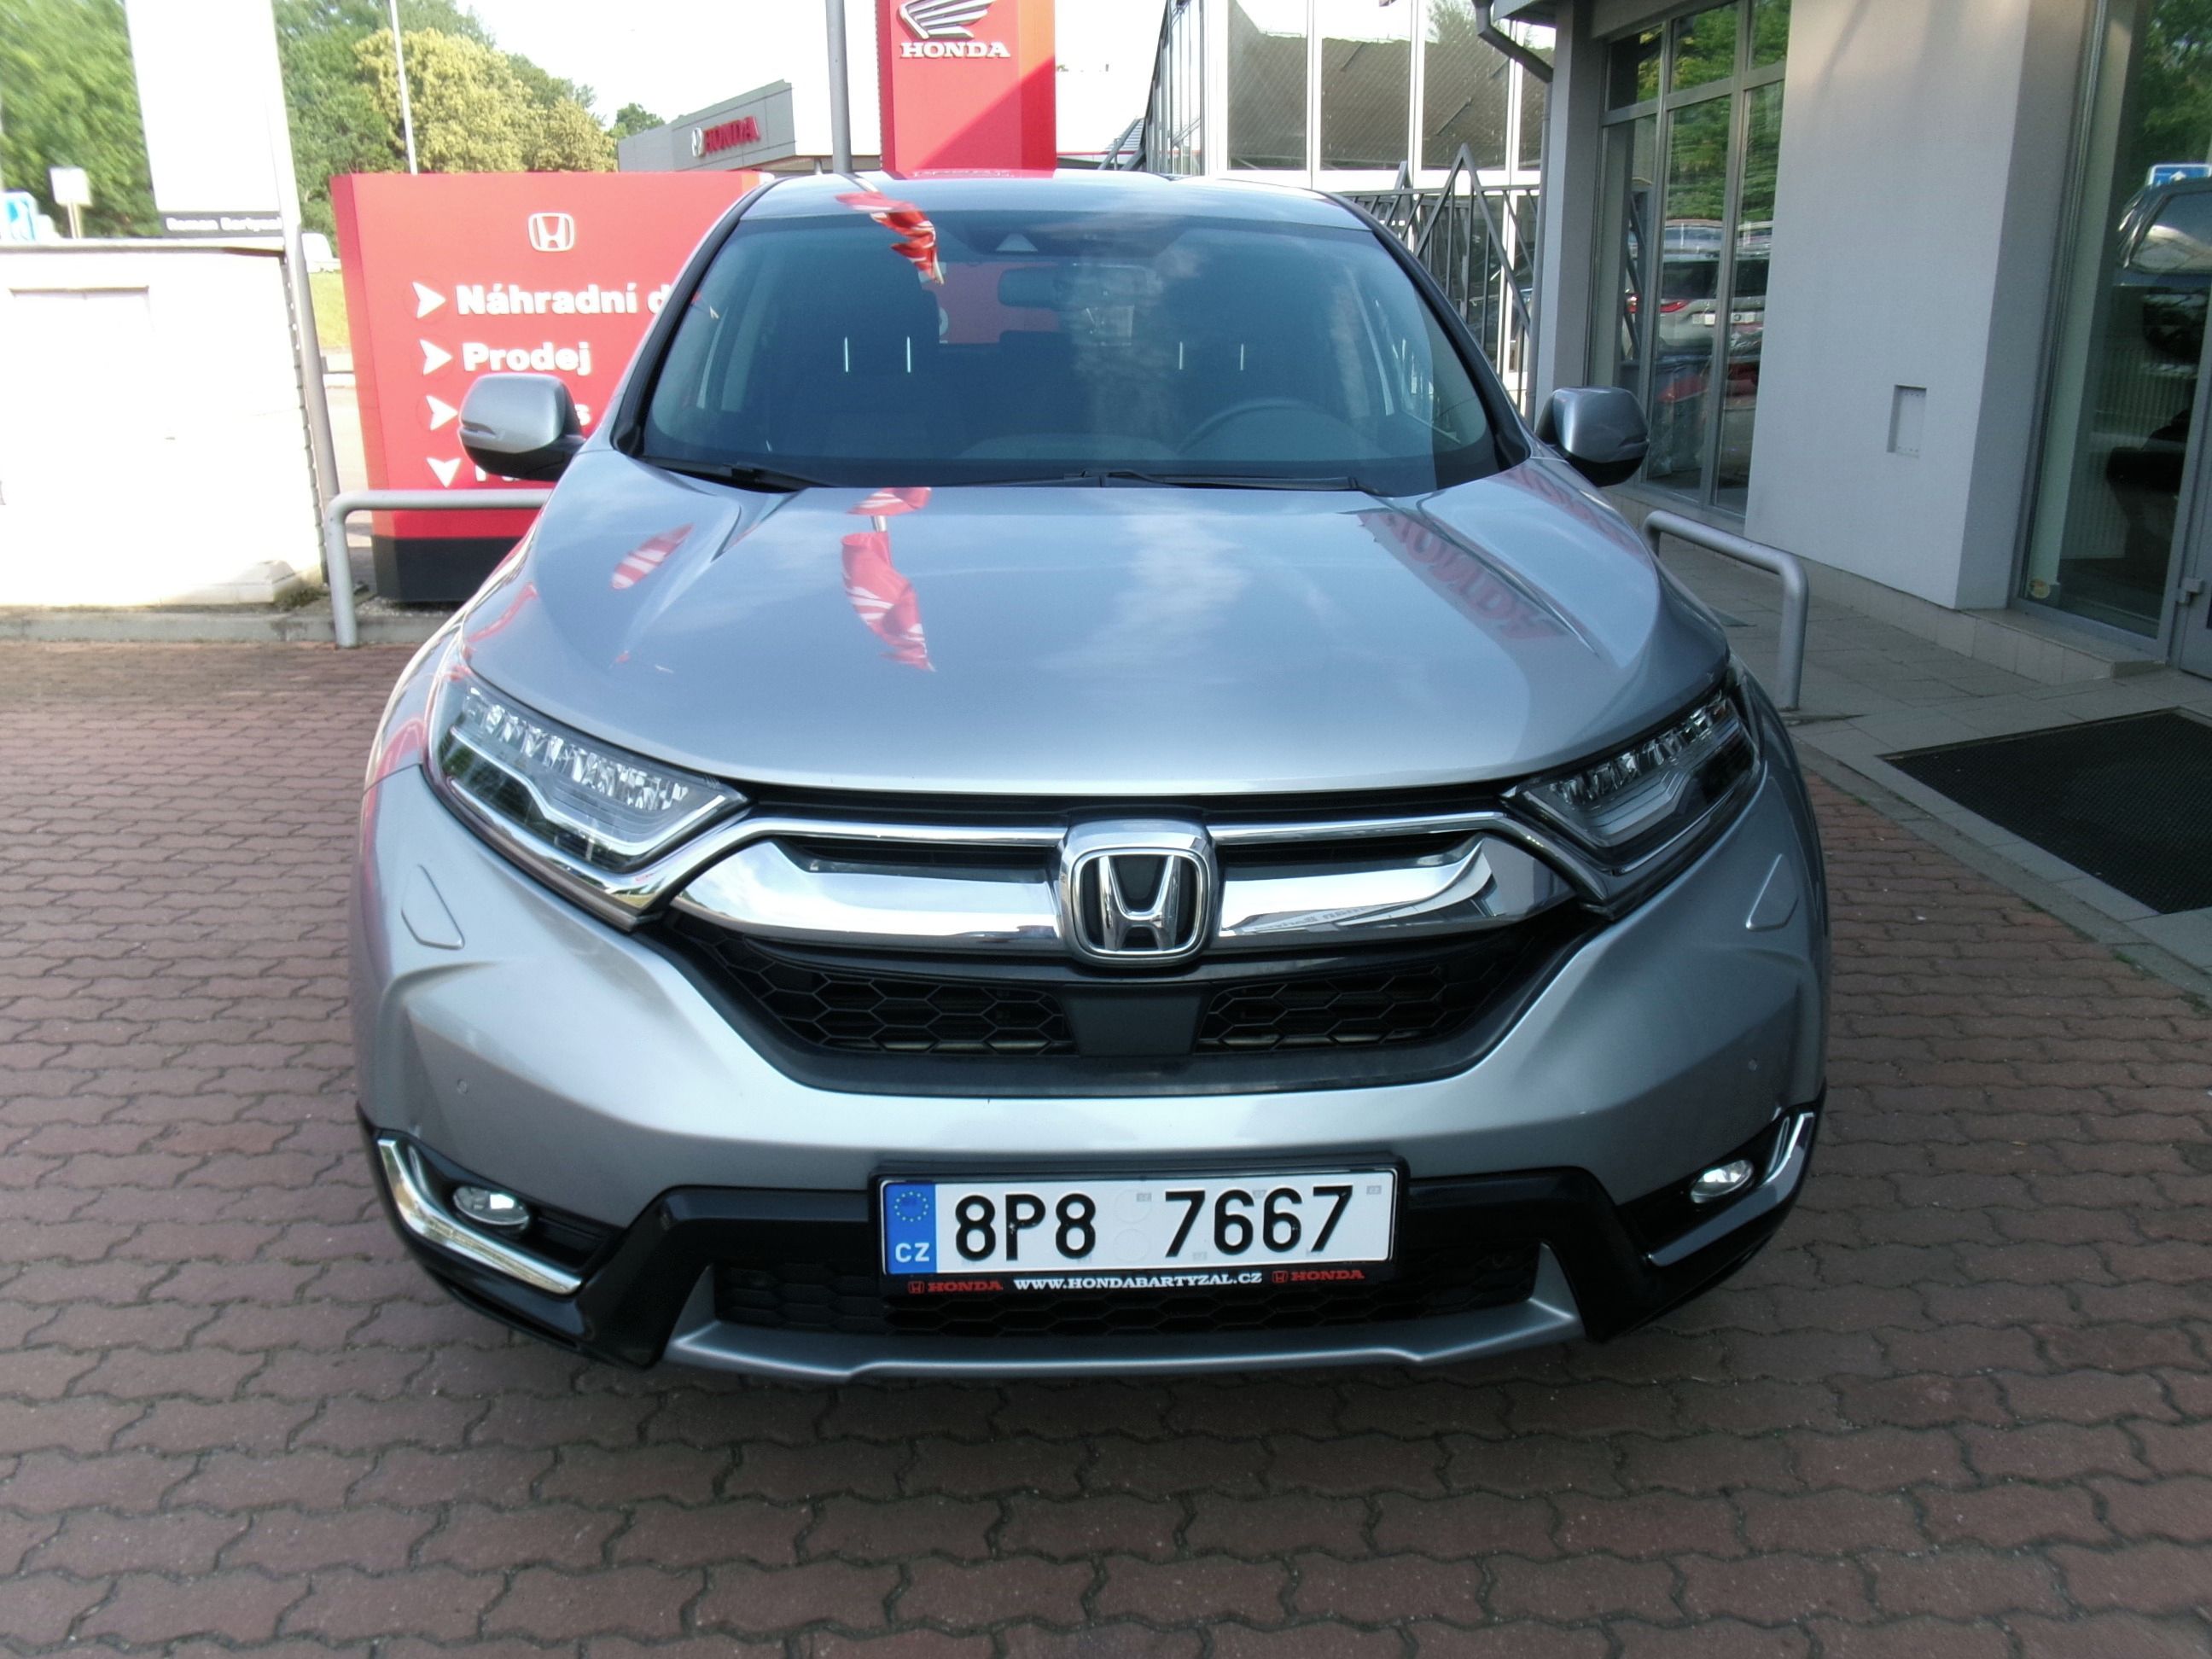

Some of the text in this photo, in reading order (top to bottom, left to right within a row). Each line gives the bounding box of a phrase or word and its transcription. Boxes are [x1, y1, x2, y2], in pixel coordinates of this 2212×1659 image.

[901, 42, 1011, 58] HONDA
[456, 282, 638, 315] Náhradní
[462, 341, 591, 375] Prodej
[955, 1185, 1353, 1261] 8P8 7667
[895, 1242, 930, 1263] CZ
[928, 1270, 1365, 1292] HONDA WWW.HONDABARTYZAL.CZ HONDA
